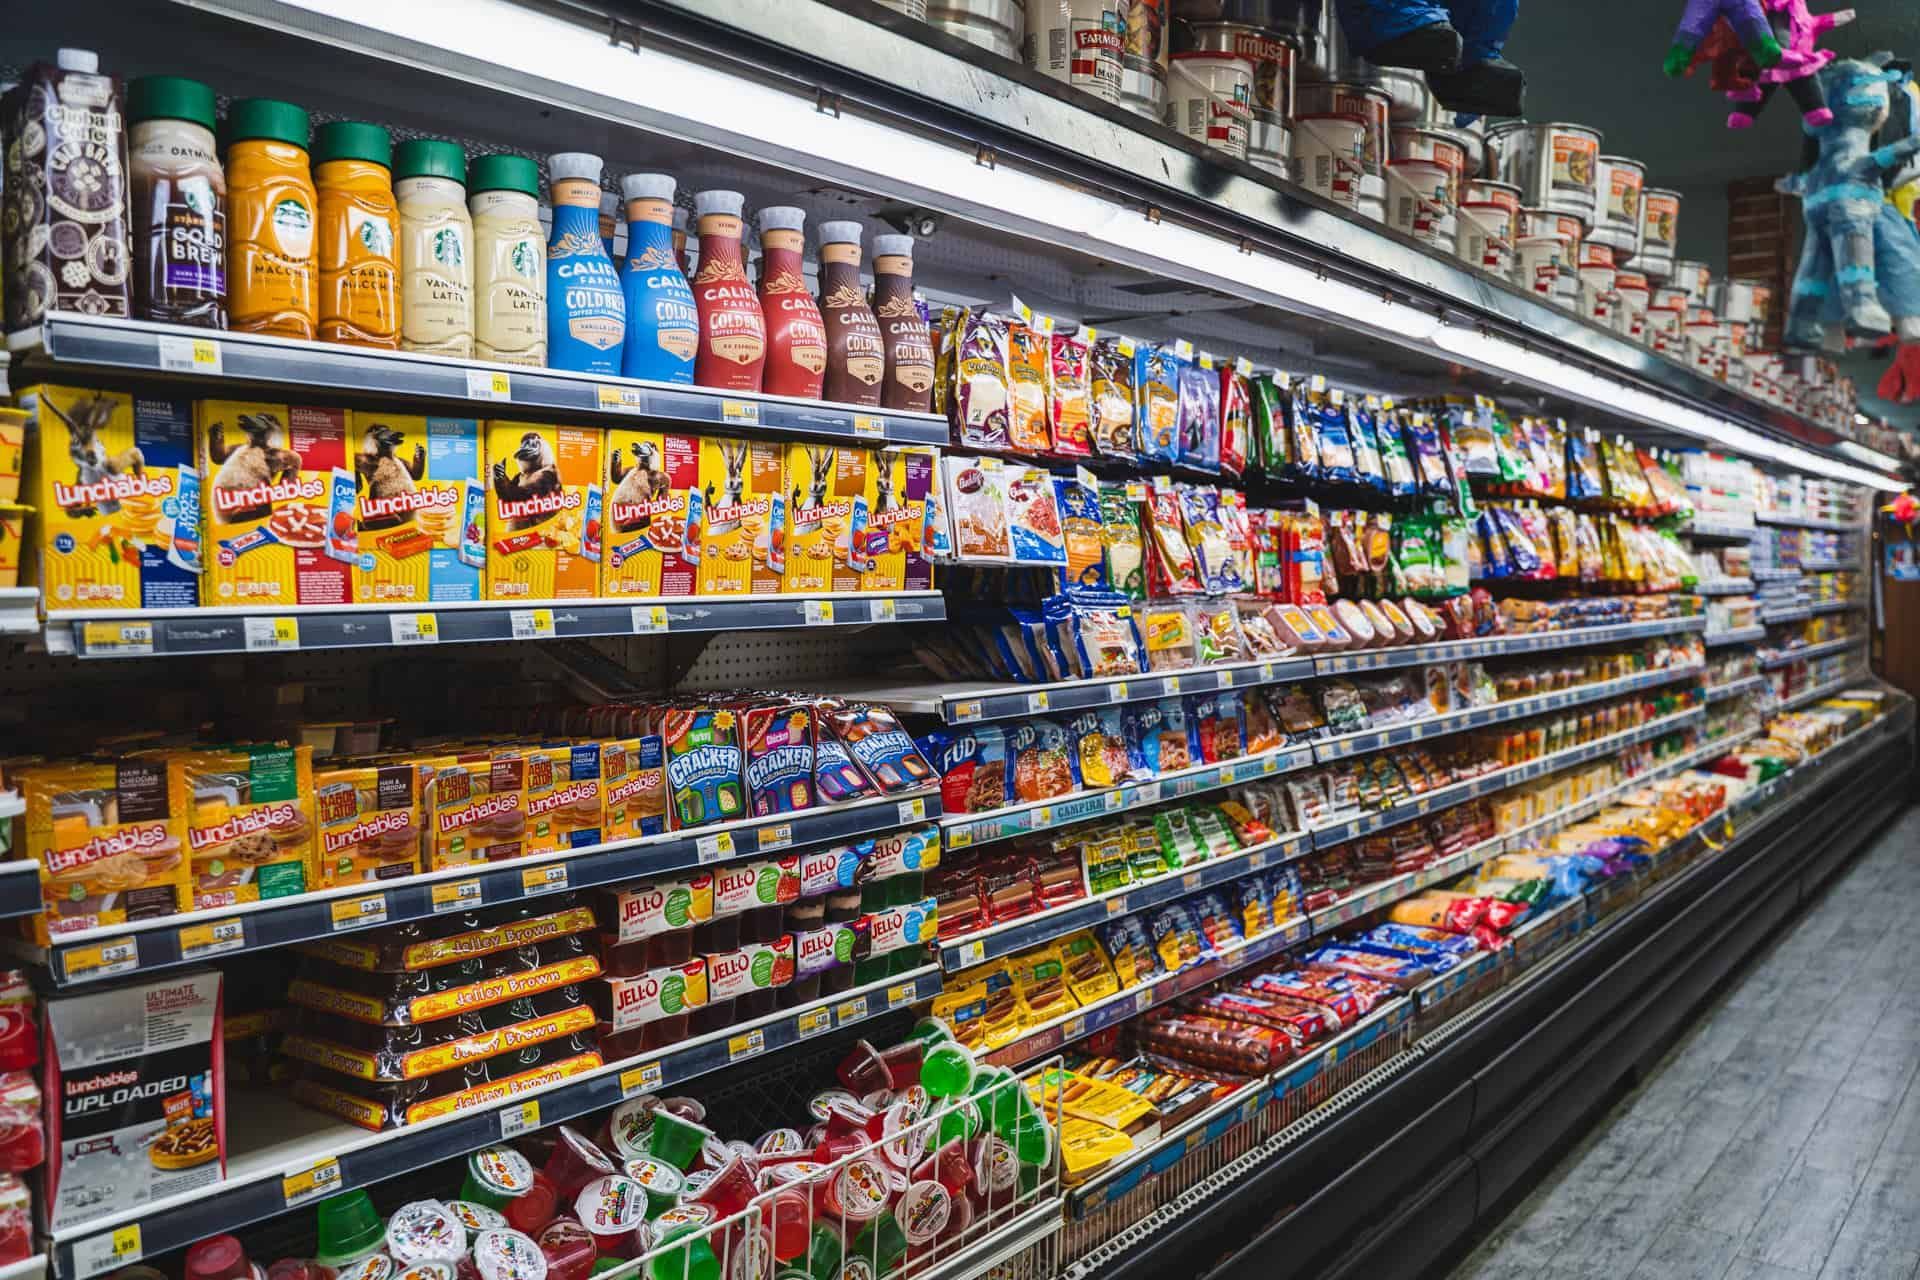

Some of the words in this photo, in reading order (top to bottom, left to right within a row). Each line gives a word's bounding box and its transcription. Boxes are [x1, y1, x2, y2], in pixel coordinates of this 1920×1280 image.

[1238, 37, 1285, 62] imusa
[566, 290, 603, 311] COLD
[656, 302, 686, 321] COLD
[55, 475, 172, 506] Lunchables
[214, 480, 324, 510] Lunchables
[360, 486, 458, 518] Lunchables
[498, 492, 581, 519] Lunchables
[612, 495, 685, 522] Lunchables
[706, 497, 770, 525] Lunchables
[793, 500, 850, 524] Lunchables
[867, 505, 922, 527] Lunchables
[855, 732, 908, 759] CRACKER
[943, 736, 977, 771] FUD
[668, 746, 742, 785] CRACKER
[750, 746, 815, 786] CRACKER
[527, 782, 598, 816] Lunchables
[607, 770, 661, 804] Lunchables
[189, 803, 294, 849] Lunchables
[440, 794, 518, 831] Lunchables
[324, 811, 409, 852] Lunchables
[46, 824, 166, 873] Lunchables
[509, 970, 561, 991] Brown
[65, 1074, 188, 1115] UPLOADED
